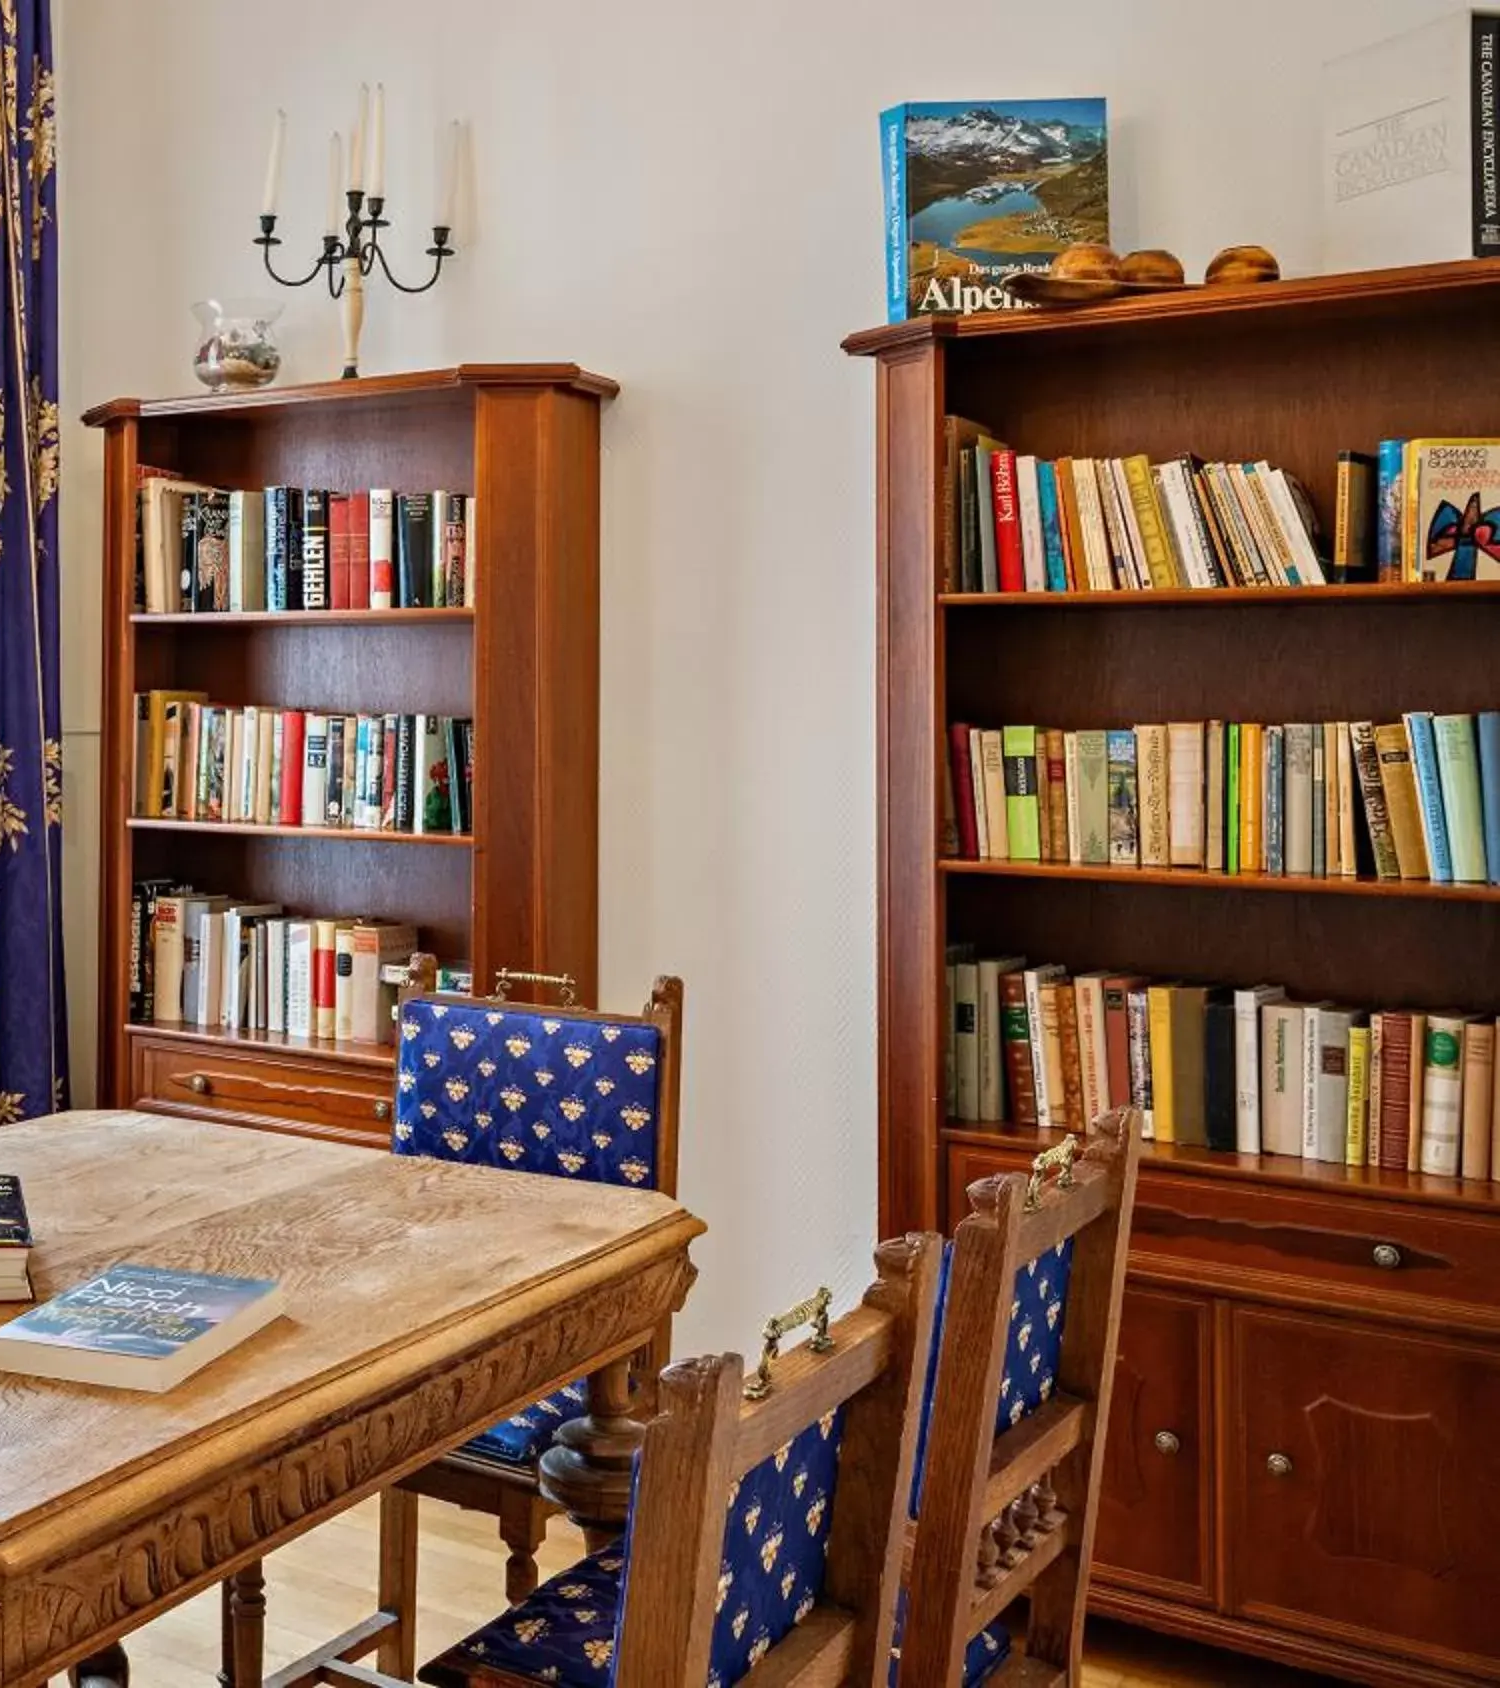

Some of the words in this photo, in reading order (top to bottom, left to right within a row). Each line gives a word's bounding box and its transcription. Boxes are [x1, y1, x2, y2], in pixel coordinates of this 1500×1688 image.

[1480, 33, 1493, 59] THE
[1481, 61, 1495, 127] CANADIAN
[1482, 130, 1497, 218] ENCYCLOPEDIA
[968, 262, 990, 276] Das
[991, 263, 1021, 277] große
[1428, 459, 1487, 469] GUARDINI
[1429, 447, 1490, 459] ROMANO
[998, 493, 1014, 523] Karl
[302, 535, 325, 607] GEHLEN
[85, 1278, 187, 1300] Nicci
[65, 1290, 206, 1317] French
